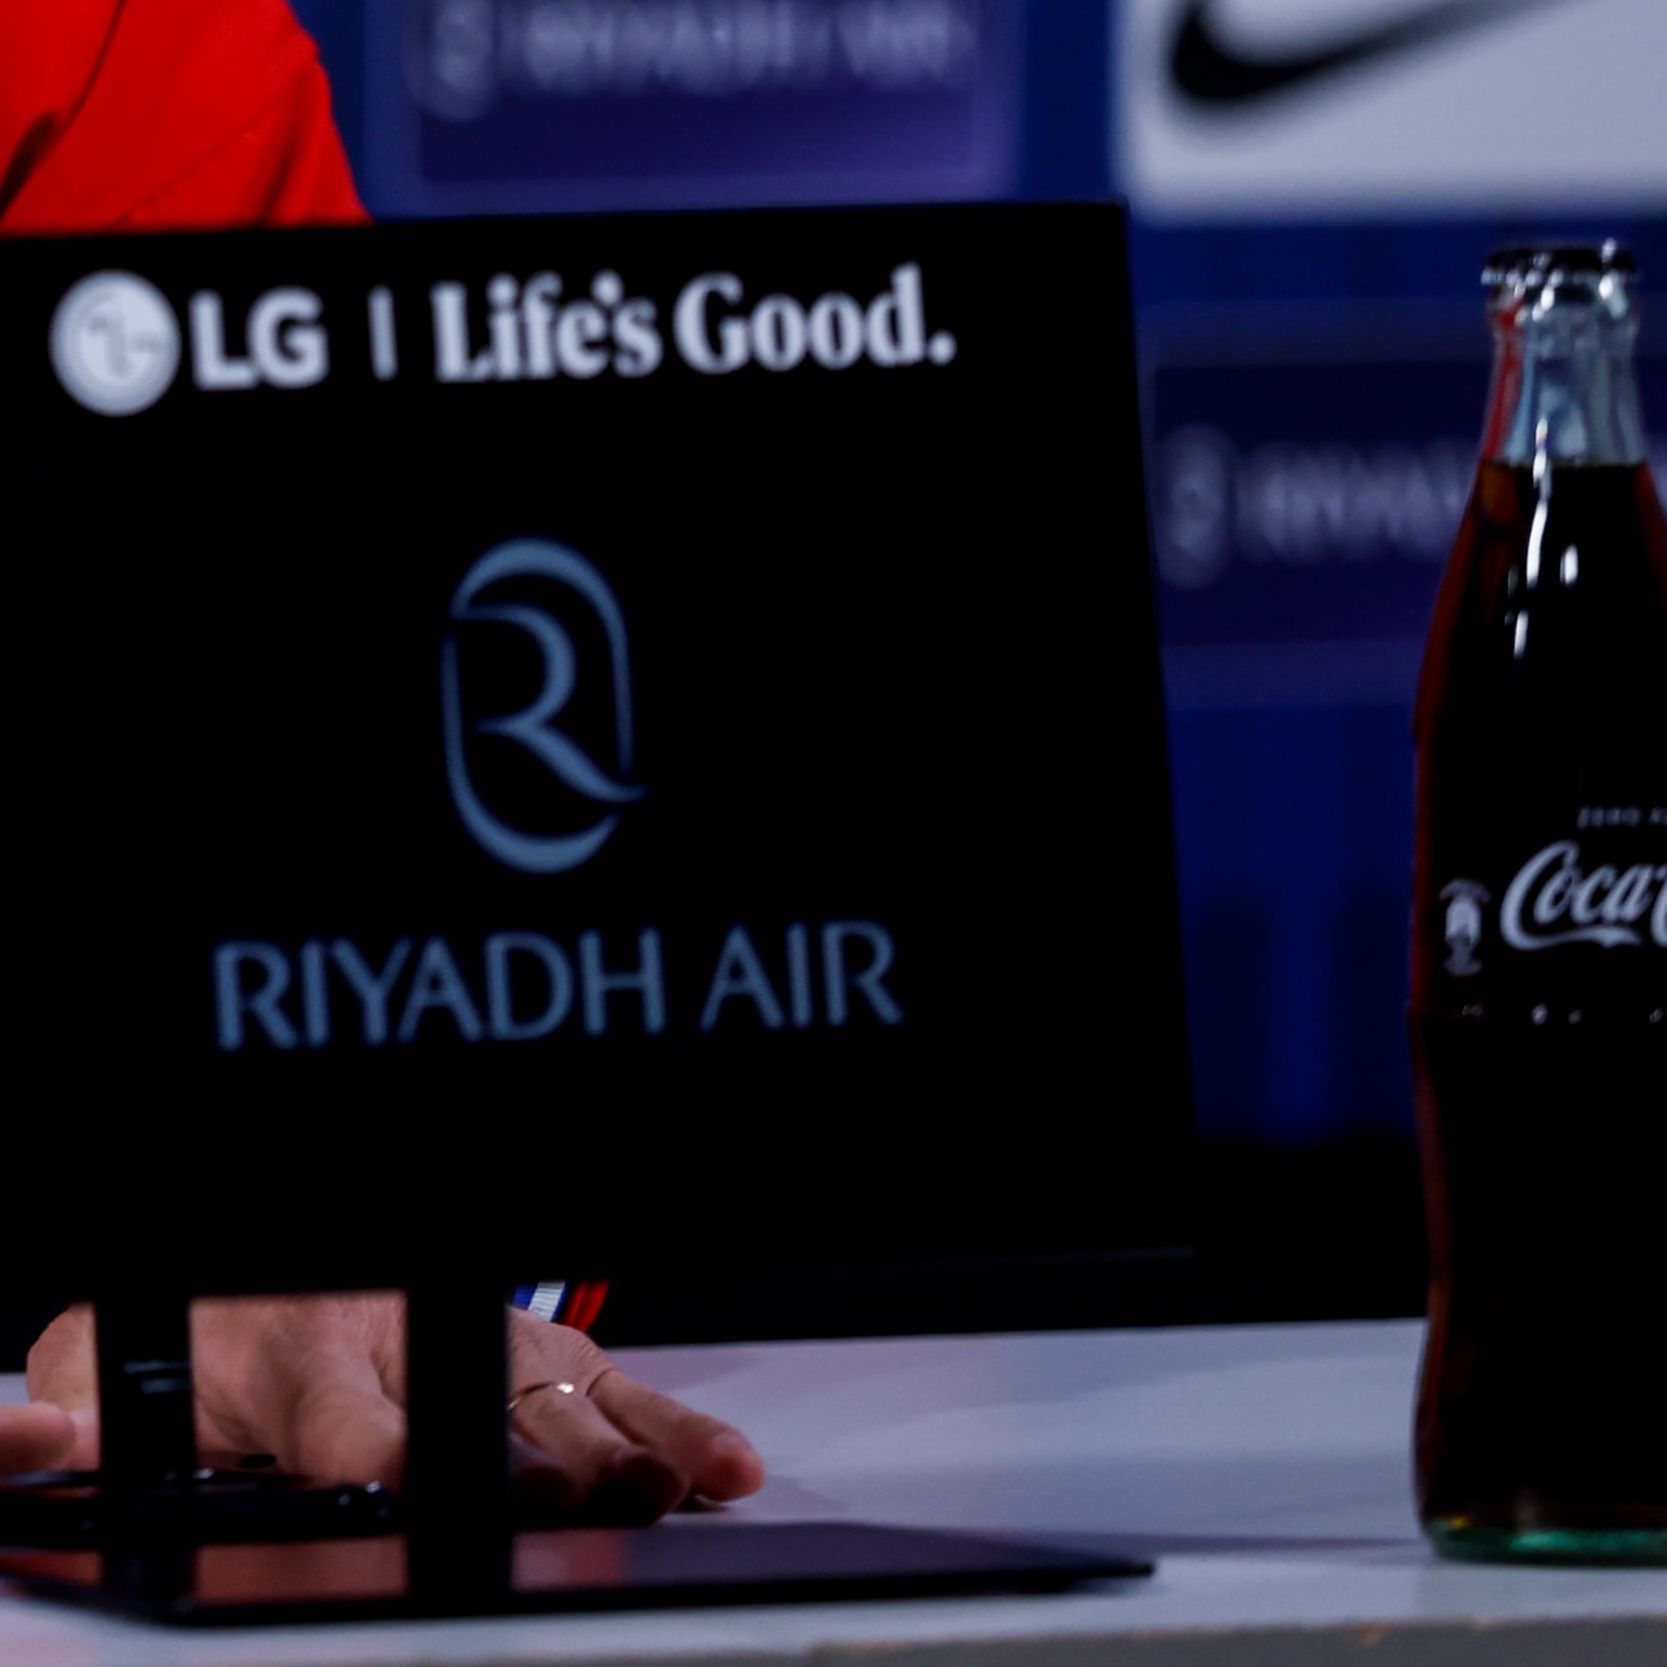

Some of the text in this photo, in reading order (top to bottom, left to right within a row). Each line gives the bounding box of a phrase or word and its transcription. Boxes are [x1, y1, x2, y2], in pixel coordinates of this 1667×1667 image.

[187, 262, 956, 392] LG Life's Good.
[213, 921, 902, 1051] RIYADH AIR
